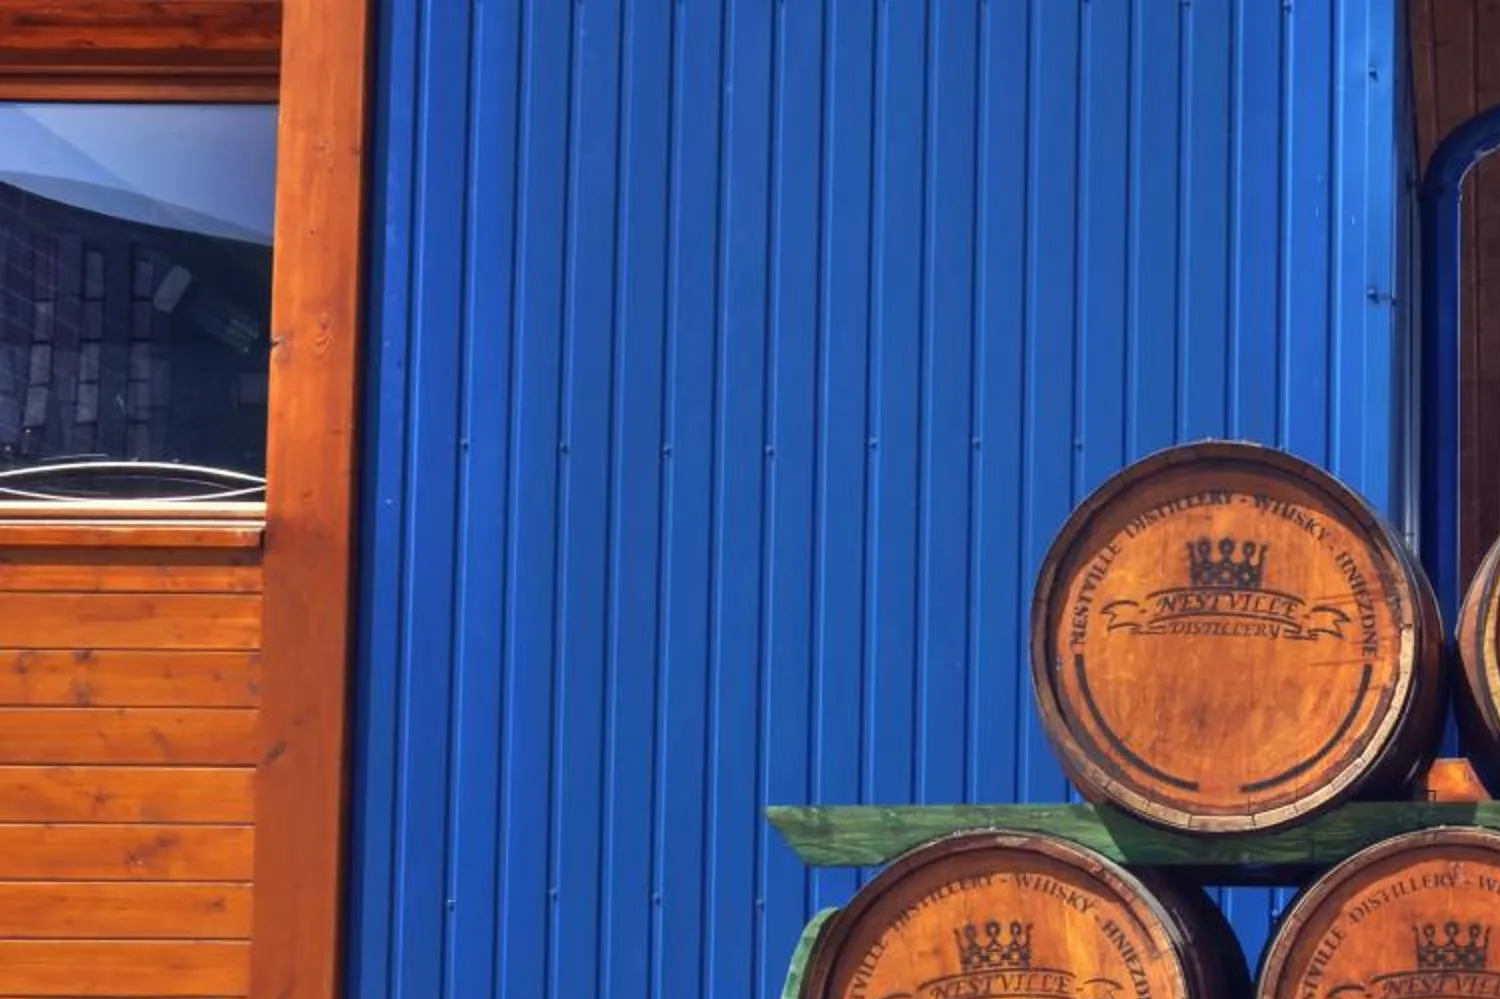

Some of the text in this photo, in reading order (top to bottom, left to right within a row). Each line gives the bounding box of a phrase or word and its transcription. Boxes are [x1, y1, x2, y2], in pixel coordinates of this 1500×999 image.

[1157, 591, 1298, 619] NESTVILLE
[1168, 620, 1281, 640] DISTILLERY
[1016, 872, 1094, 913] WHISKY
[1349, 871, 1459, 925] DISTILLERY
